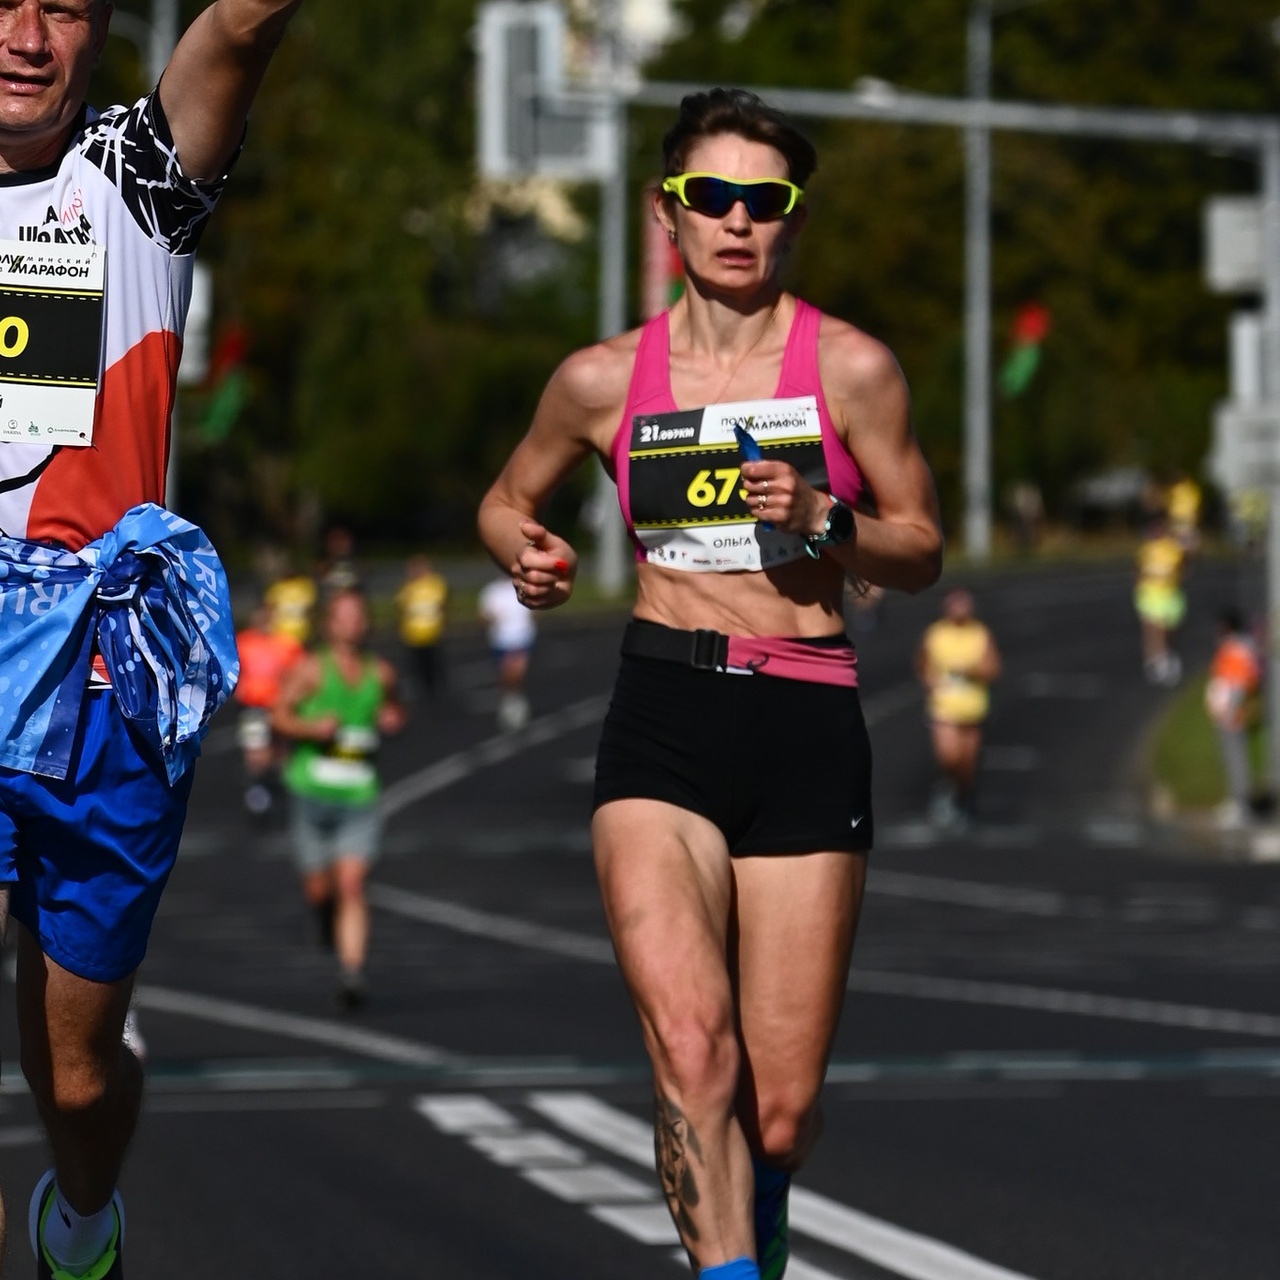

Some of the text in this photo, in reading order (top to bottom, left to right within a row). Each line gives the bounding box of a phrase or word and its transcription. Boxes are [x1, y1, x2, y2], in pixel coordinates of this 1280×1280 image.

[26, 256, 91, 265] МИНСКИЙ
[11, 263, 89, 278] МАРАФОН
[745, 418, 807, 431] МАРАФОН
[687, 468, 749, 507] 67
[713, 537, 752, 548] ОЛЬГА
